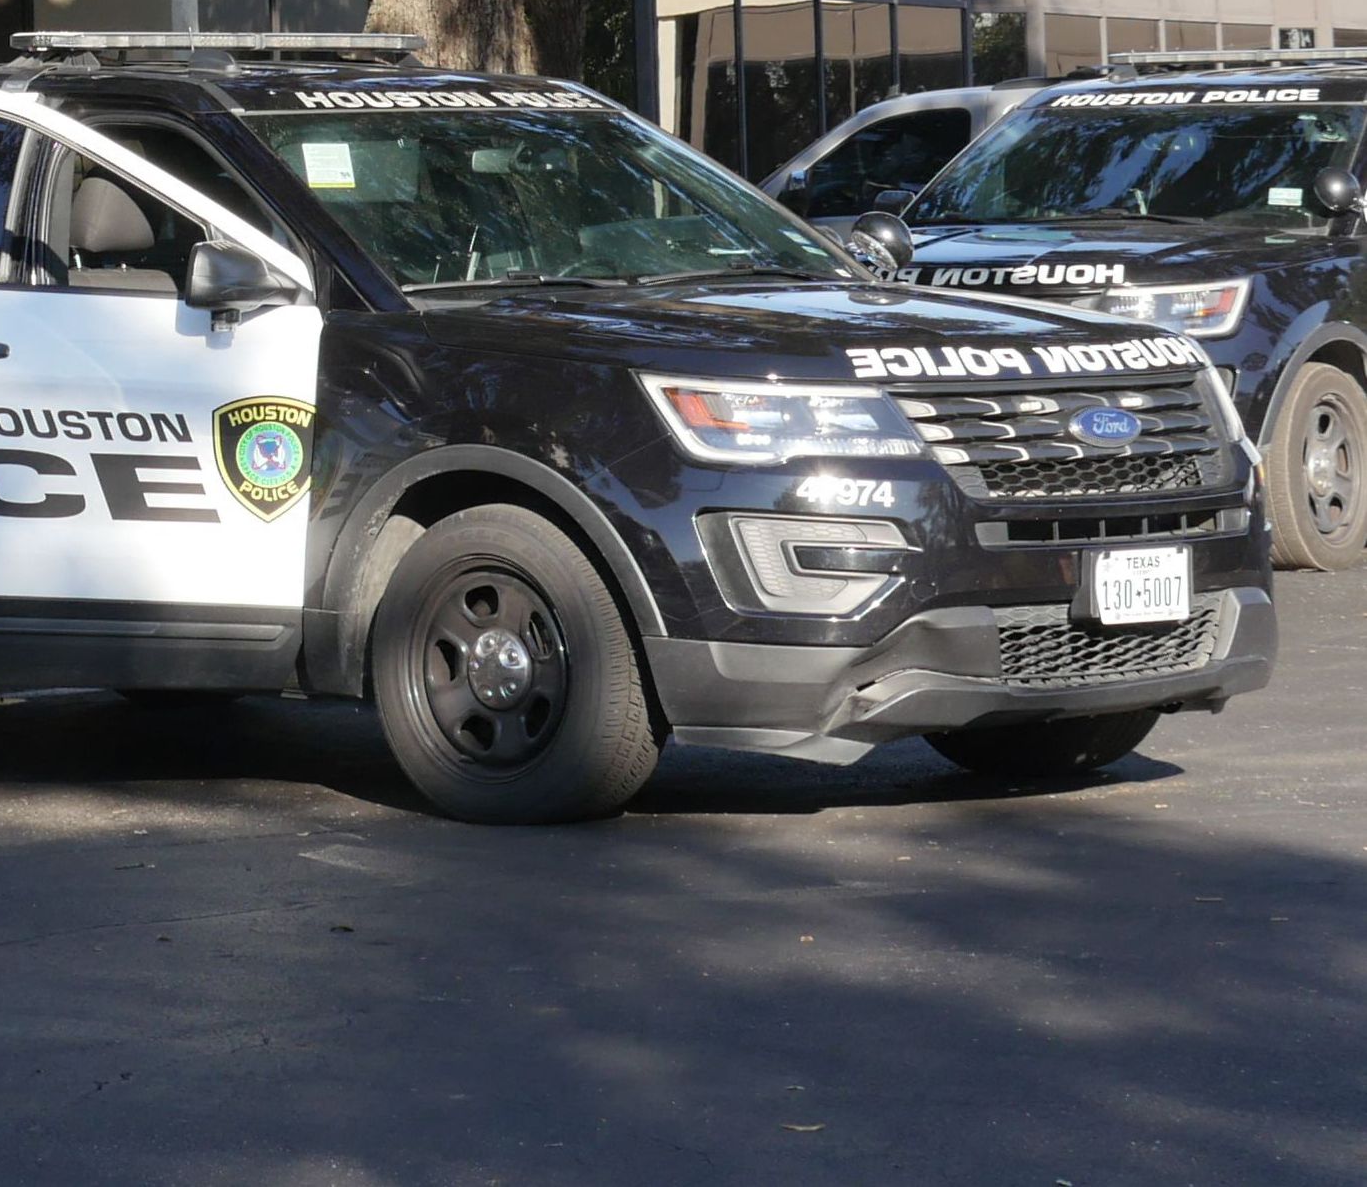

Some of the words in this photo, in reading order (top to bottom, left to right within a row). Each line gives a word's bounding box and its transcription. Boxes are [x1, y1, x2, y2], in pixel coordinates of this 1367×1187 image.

[294, 90, 497, 109] HOUSTON
[1051, 91, 1194, 107] HOUSTON
[1201, 88, 1320, 104] POLICE
[228, 405, 312, 428] HOUSTON
[1092, 412, 1131, 434] Ford
[239, 480, 300, 502] POLICE
[796, 475, 895, 508] 4974
[1126, 556, 1161, 570] TEXAS
